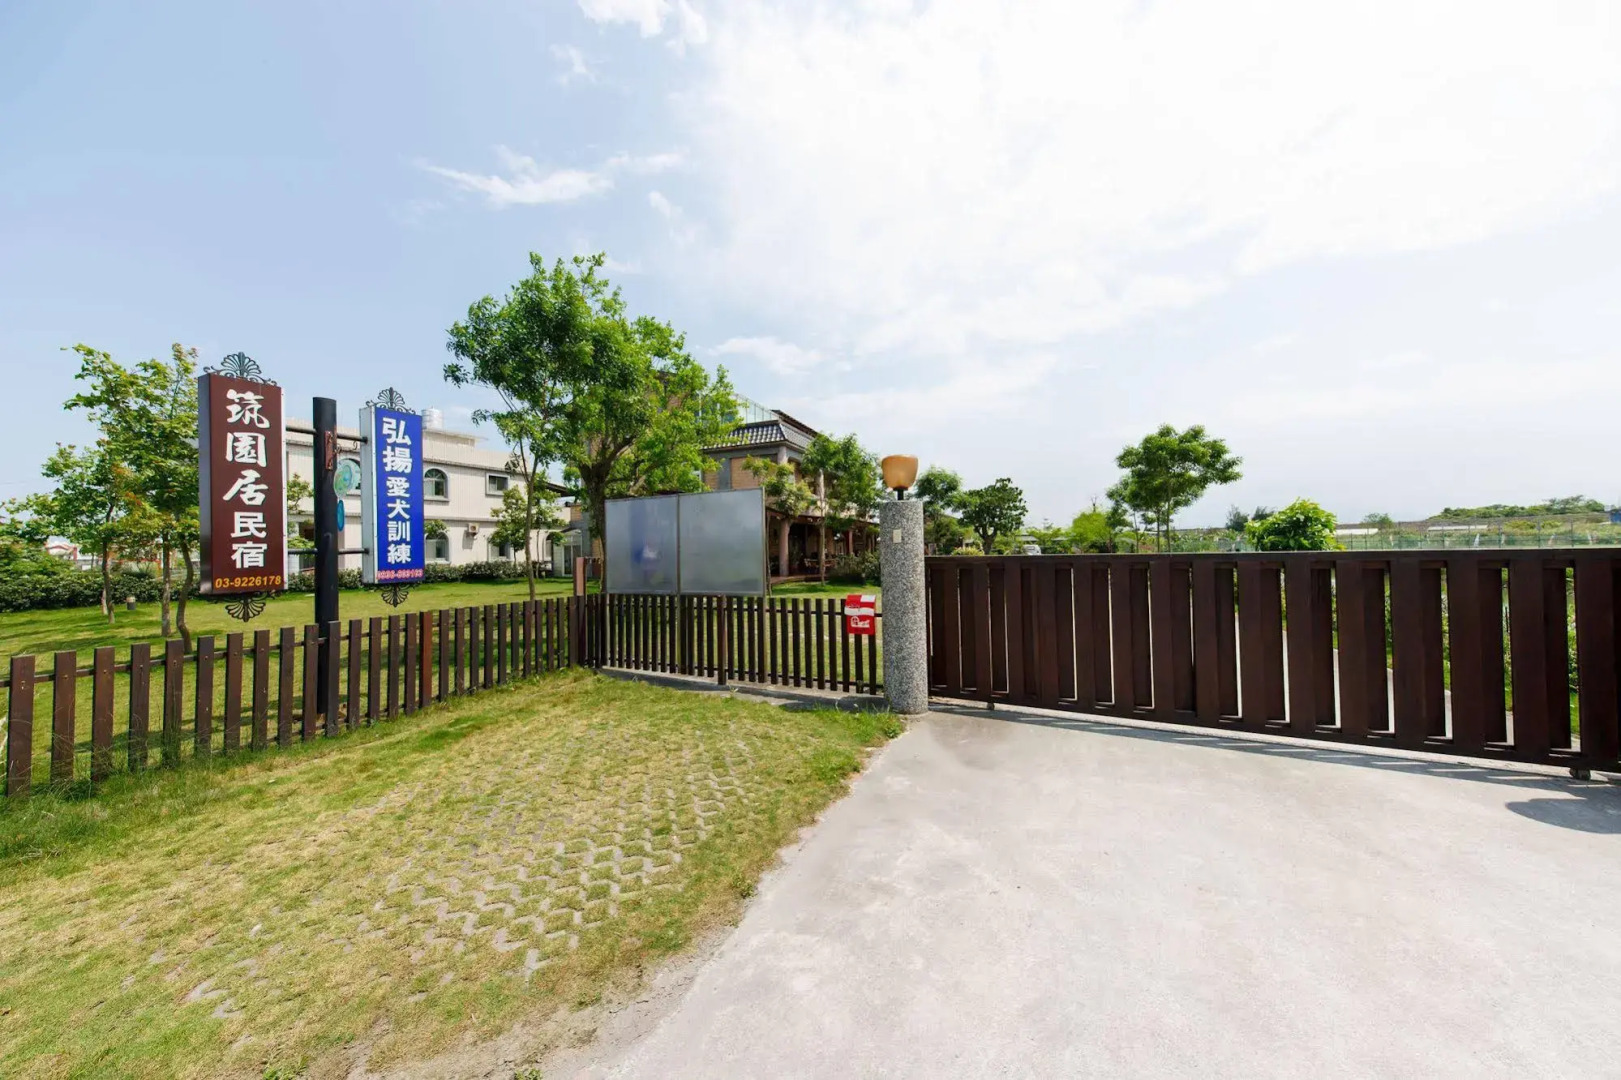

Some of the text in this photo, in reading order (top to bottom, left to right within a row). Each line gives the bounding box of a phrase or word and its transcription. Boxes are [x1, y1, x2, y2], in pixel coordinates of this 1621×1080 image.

[222, 388, 270, 569] 筑園居民宿
[382, 416, 413, 565] 弘揚愛犬訓練
[215, 575, 281, 588] 03-9226178
